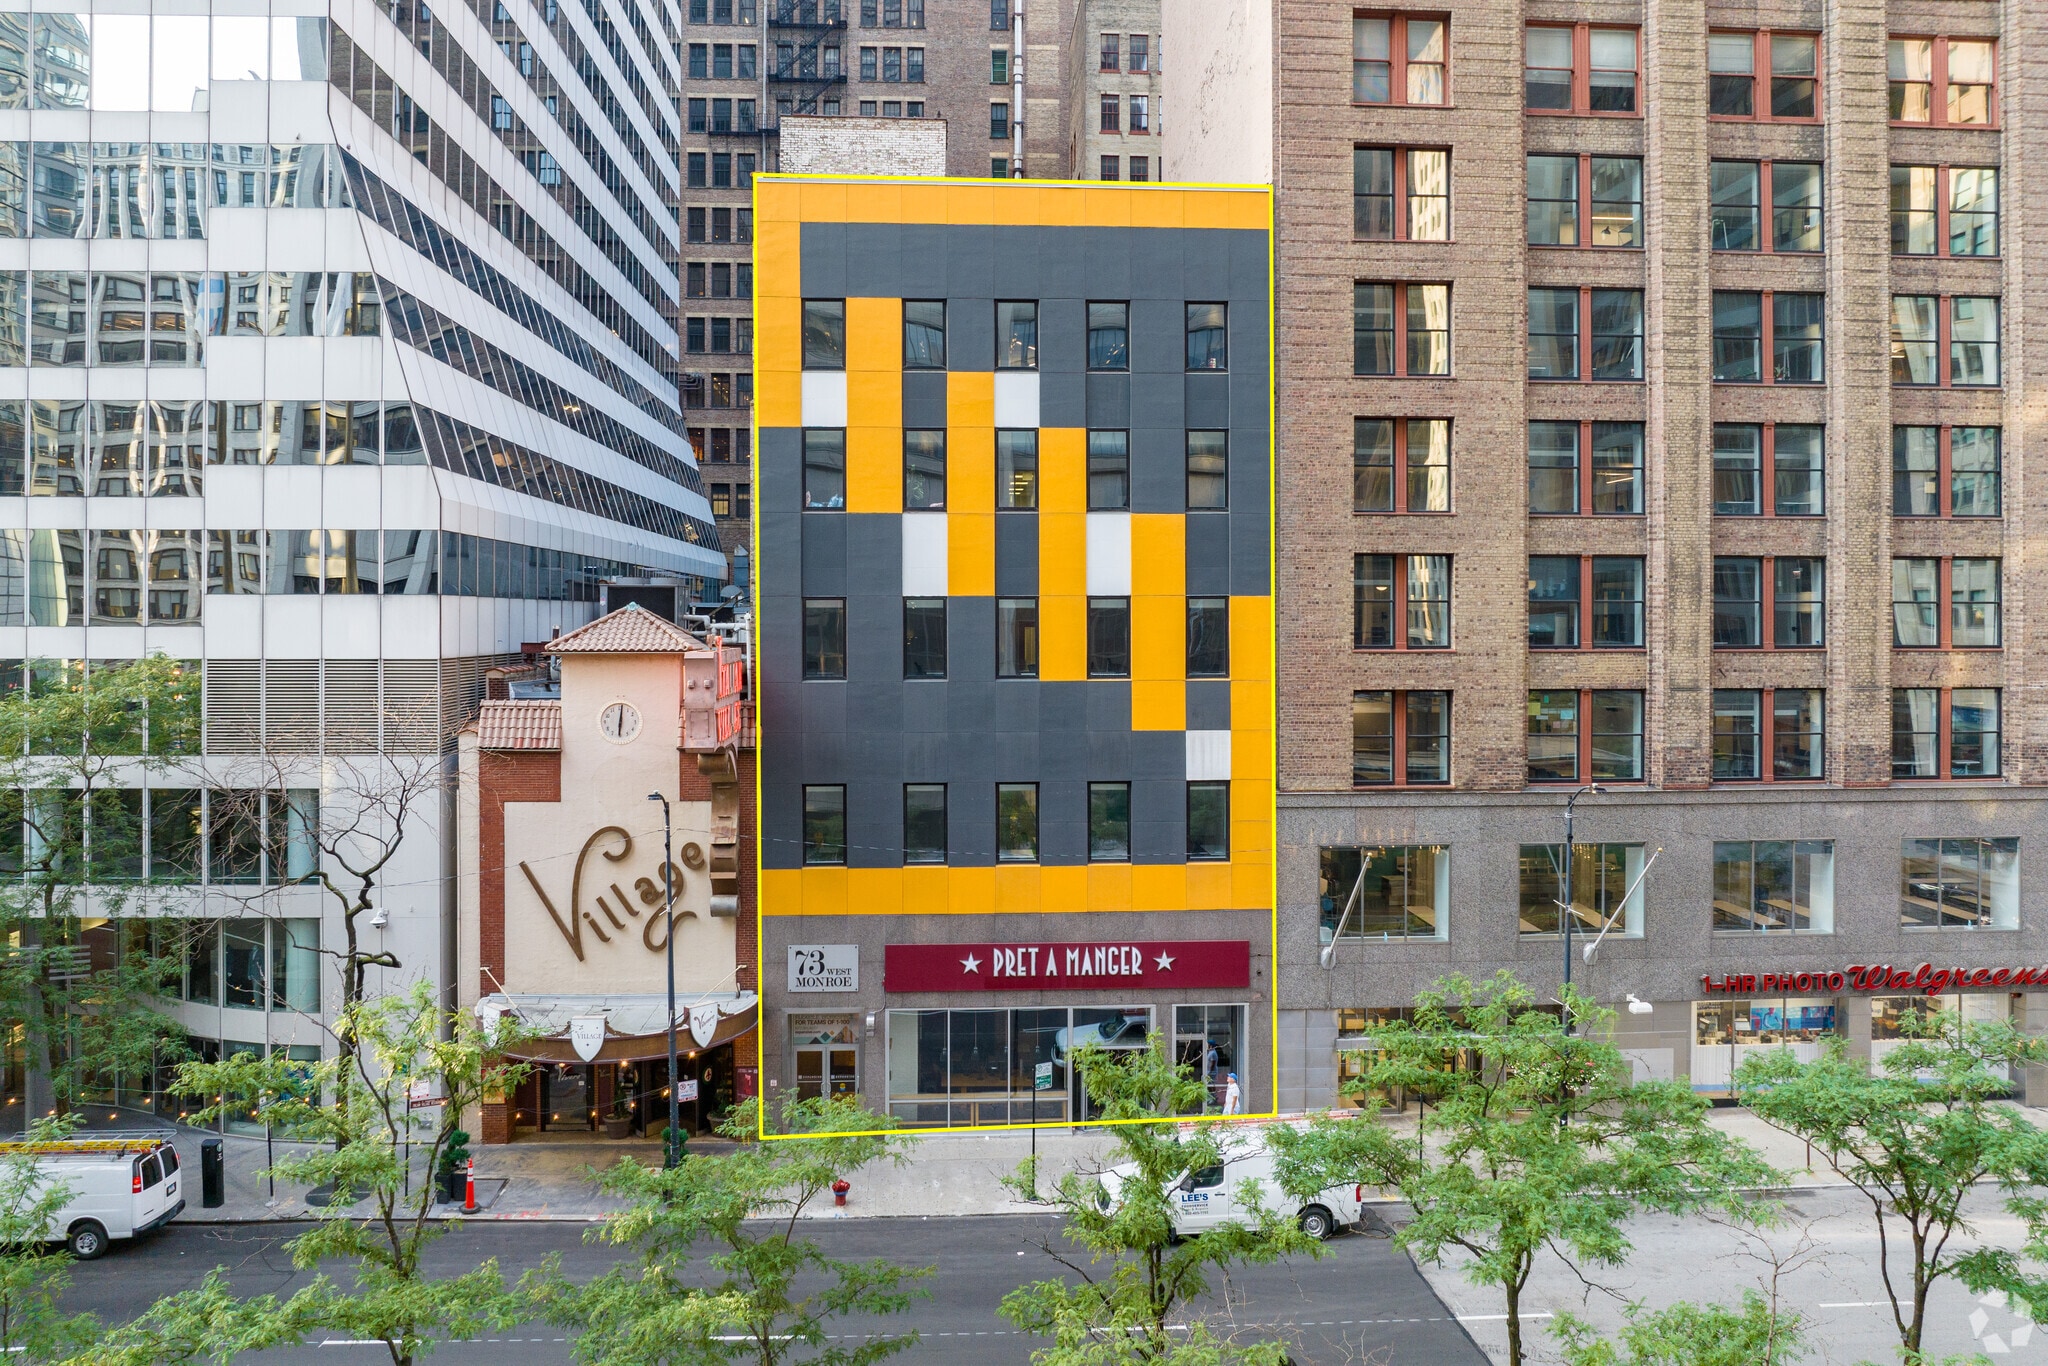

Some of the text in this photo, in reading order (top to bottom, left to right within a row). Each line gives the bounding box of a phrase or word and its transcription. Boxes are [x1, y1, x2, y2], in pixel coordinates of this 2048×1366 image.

[519, 826, 706, 962] Village
[795, 950, 825, 975] 73
[993, 946, 1143, 977] PRET A MANGER
[796, 977, 852, 987] MONROE
[1702, 972, 1845, 993] 1-HR PHOTO
[1181, 1193, 1209, 1202] LEE'S
